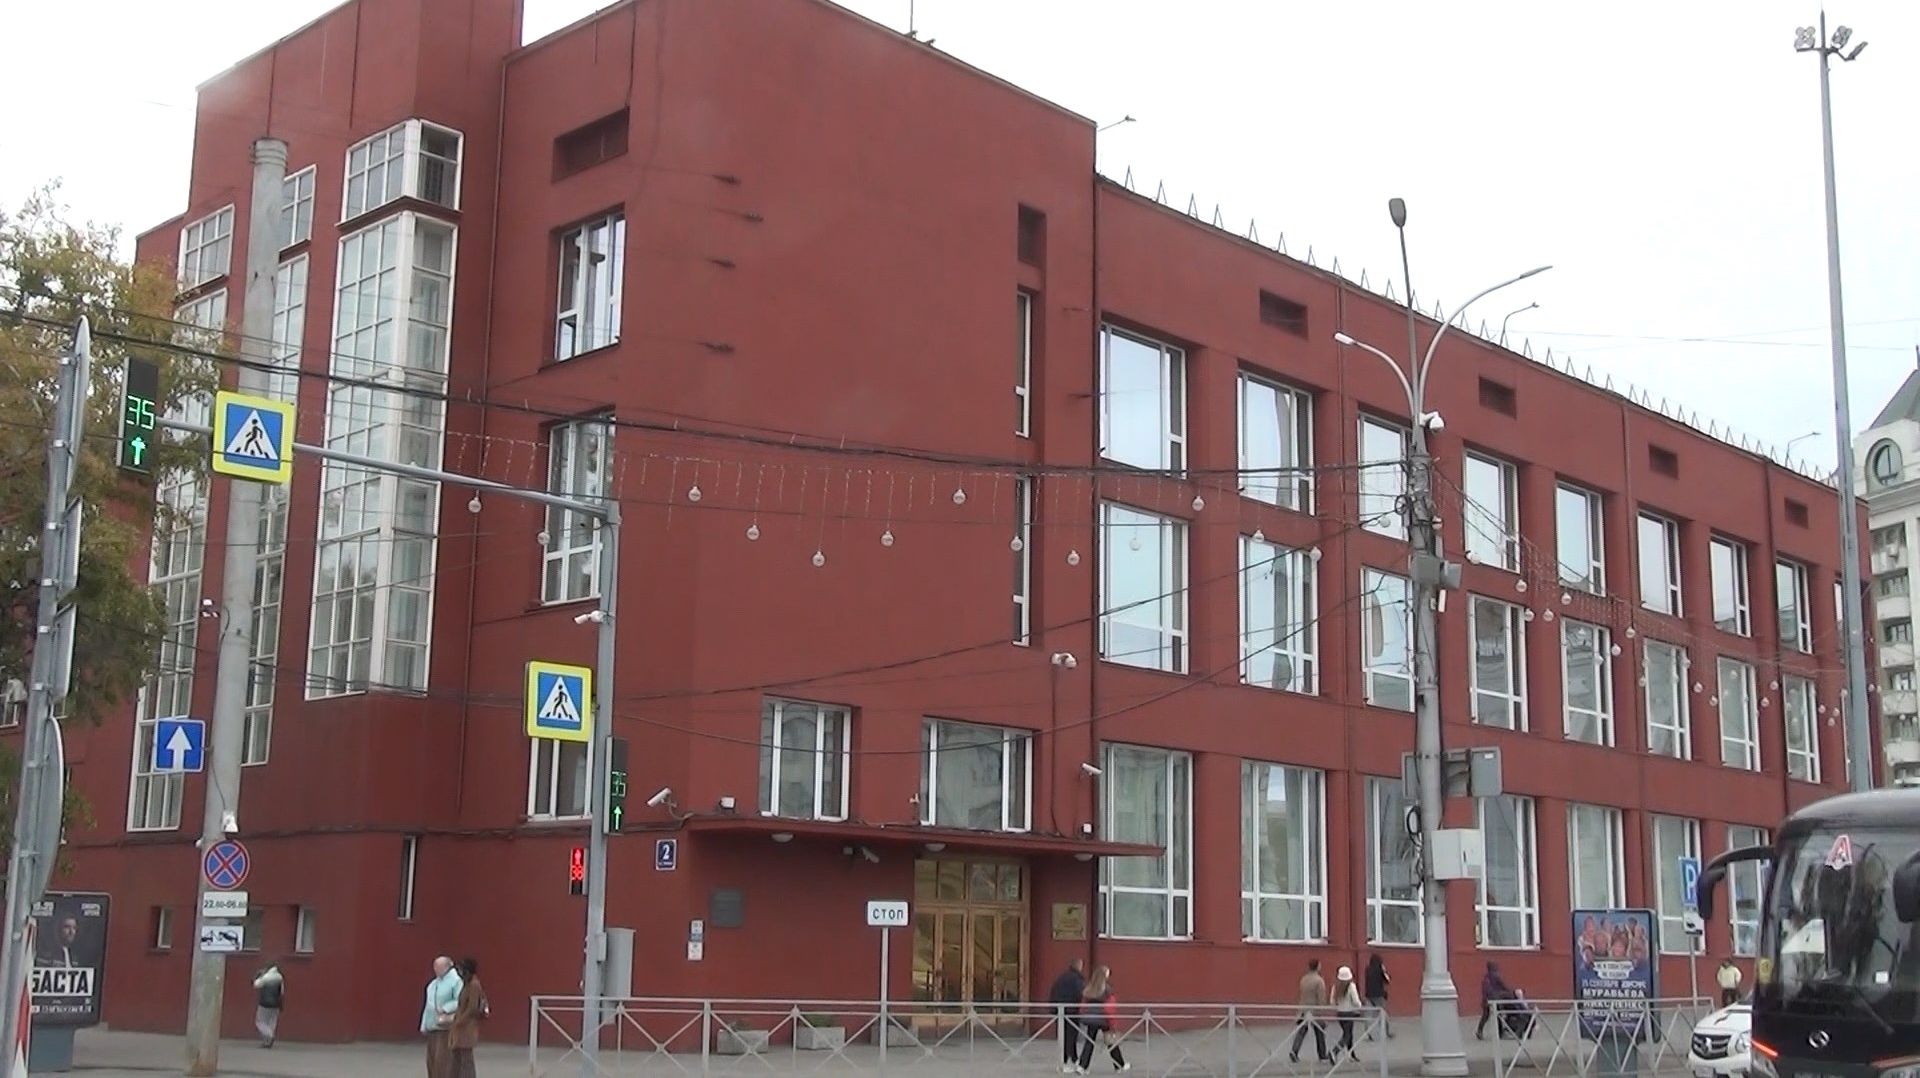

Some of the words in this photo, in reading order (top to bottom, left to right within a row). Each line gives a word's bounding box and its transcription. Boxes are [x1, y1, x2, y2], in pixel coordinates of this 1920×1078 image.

[126, 395, 155, 430] 35
[662, 844, 670, 860] 2
[1686, 863, 1697, 900] P
[872, 908, 904, 920] СТОП
